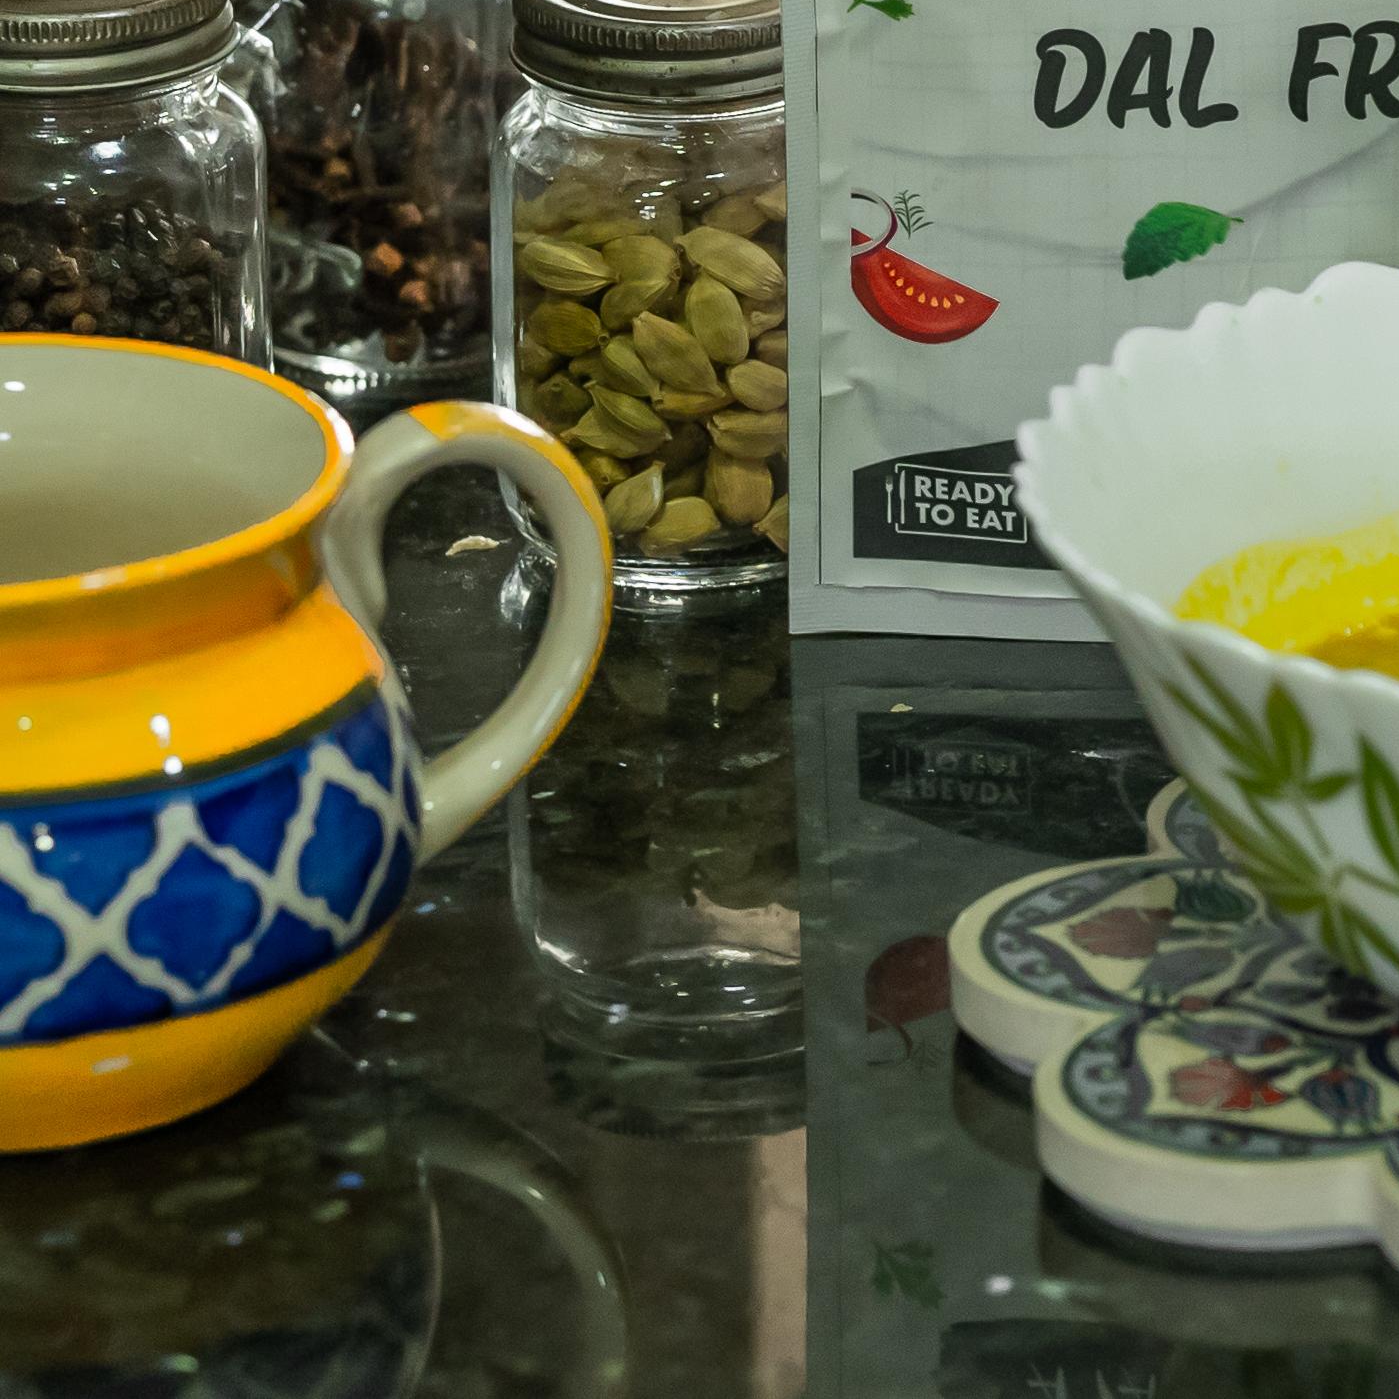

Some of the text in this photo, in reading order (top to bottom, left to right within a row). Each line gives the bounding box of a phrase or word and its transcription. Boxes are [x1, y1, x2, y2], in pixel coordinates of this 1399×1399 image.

[1033, 26, 1240, 130] DAL
[914, 474, 1015, 507] READY
[915, 502, 1017, 532] TO EAT
